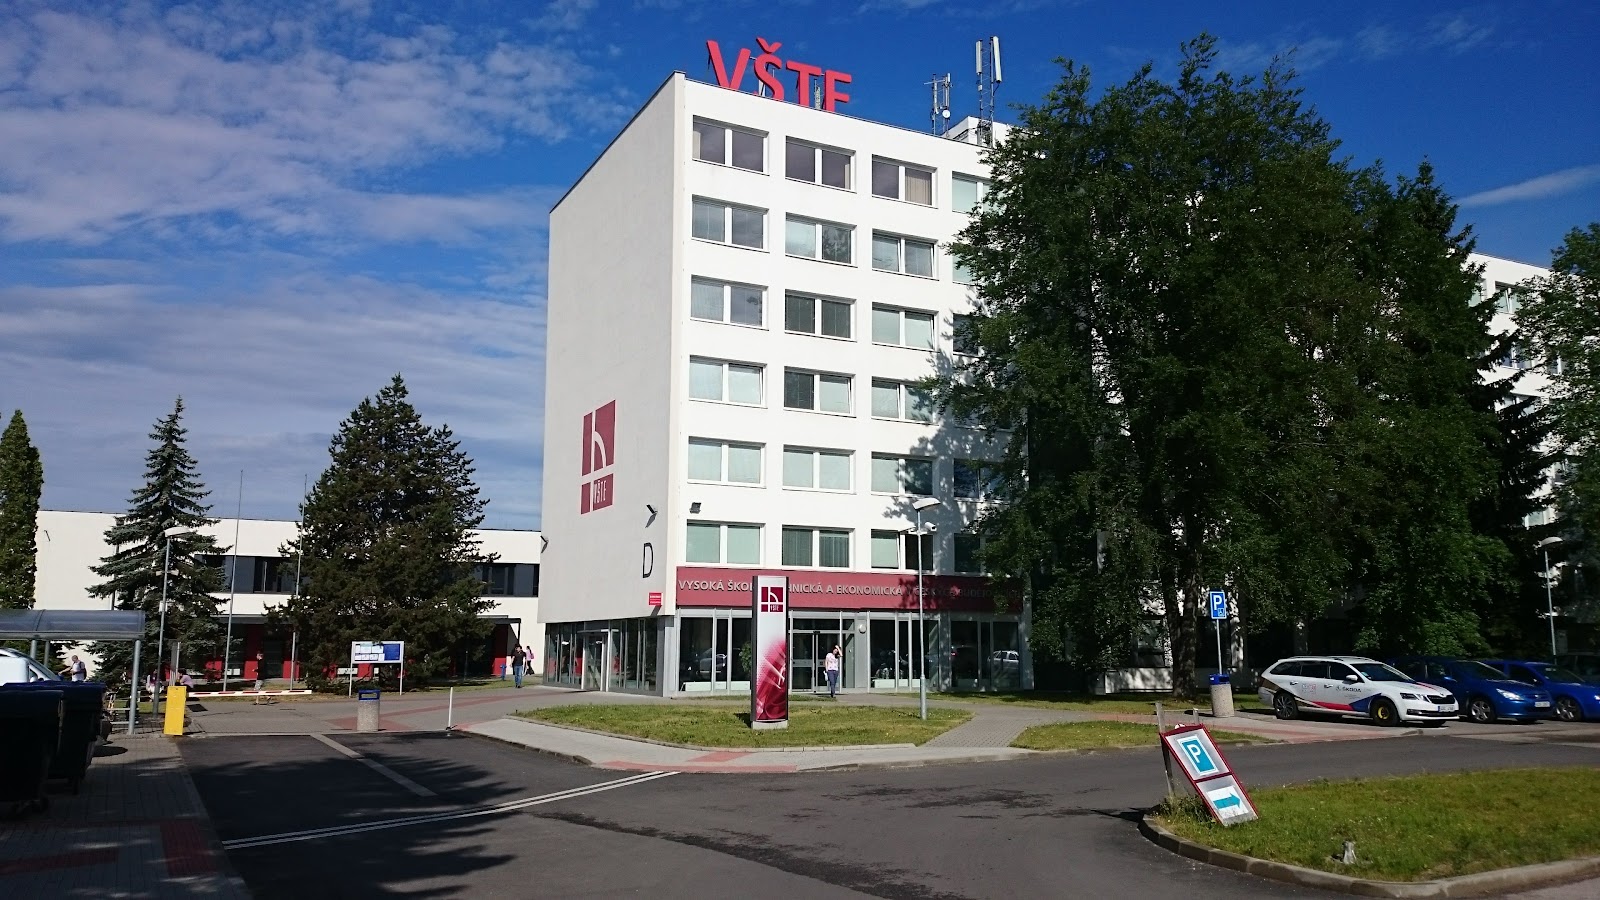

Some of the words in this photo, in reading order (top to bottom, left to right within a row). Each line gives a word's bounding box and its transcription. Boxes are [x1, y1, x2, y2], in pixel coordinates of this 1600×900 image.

[706, 36, 852, 113] VŠTE
[642, 542, 654, 578] D
[678, 580, 724, 592] VYSOKÁ
[826, 585, 834, 594] A
[836, 584, 903, 597] EKONOMICKÁ
[1213, 594, 1222, 611] P
[1187, 744, 1201, 763] P
